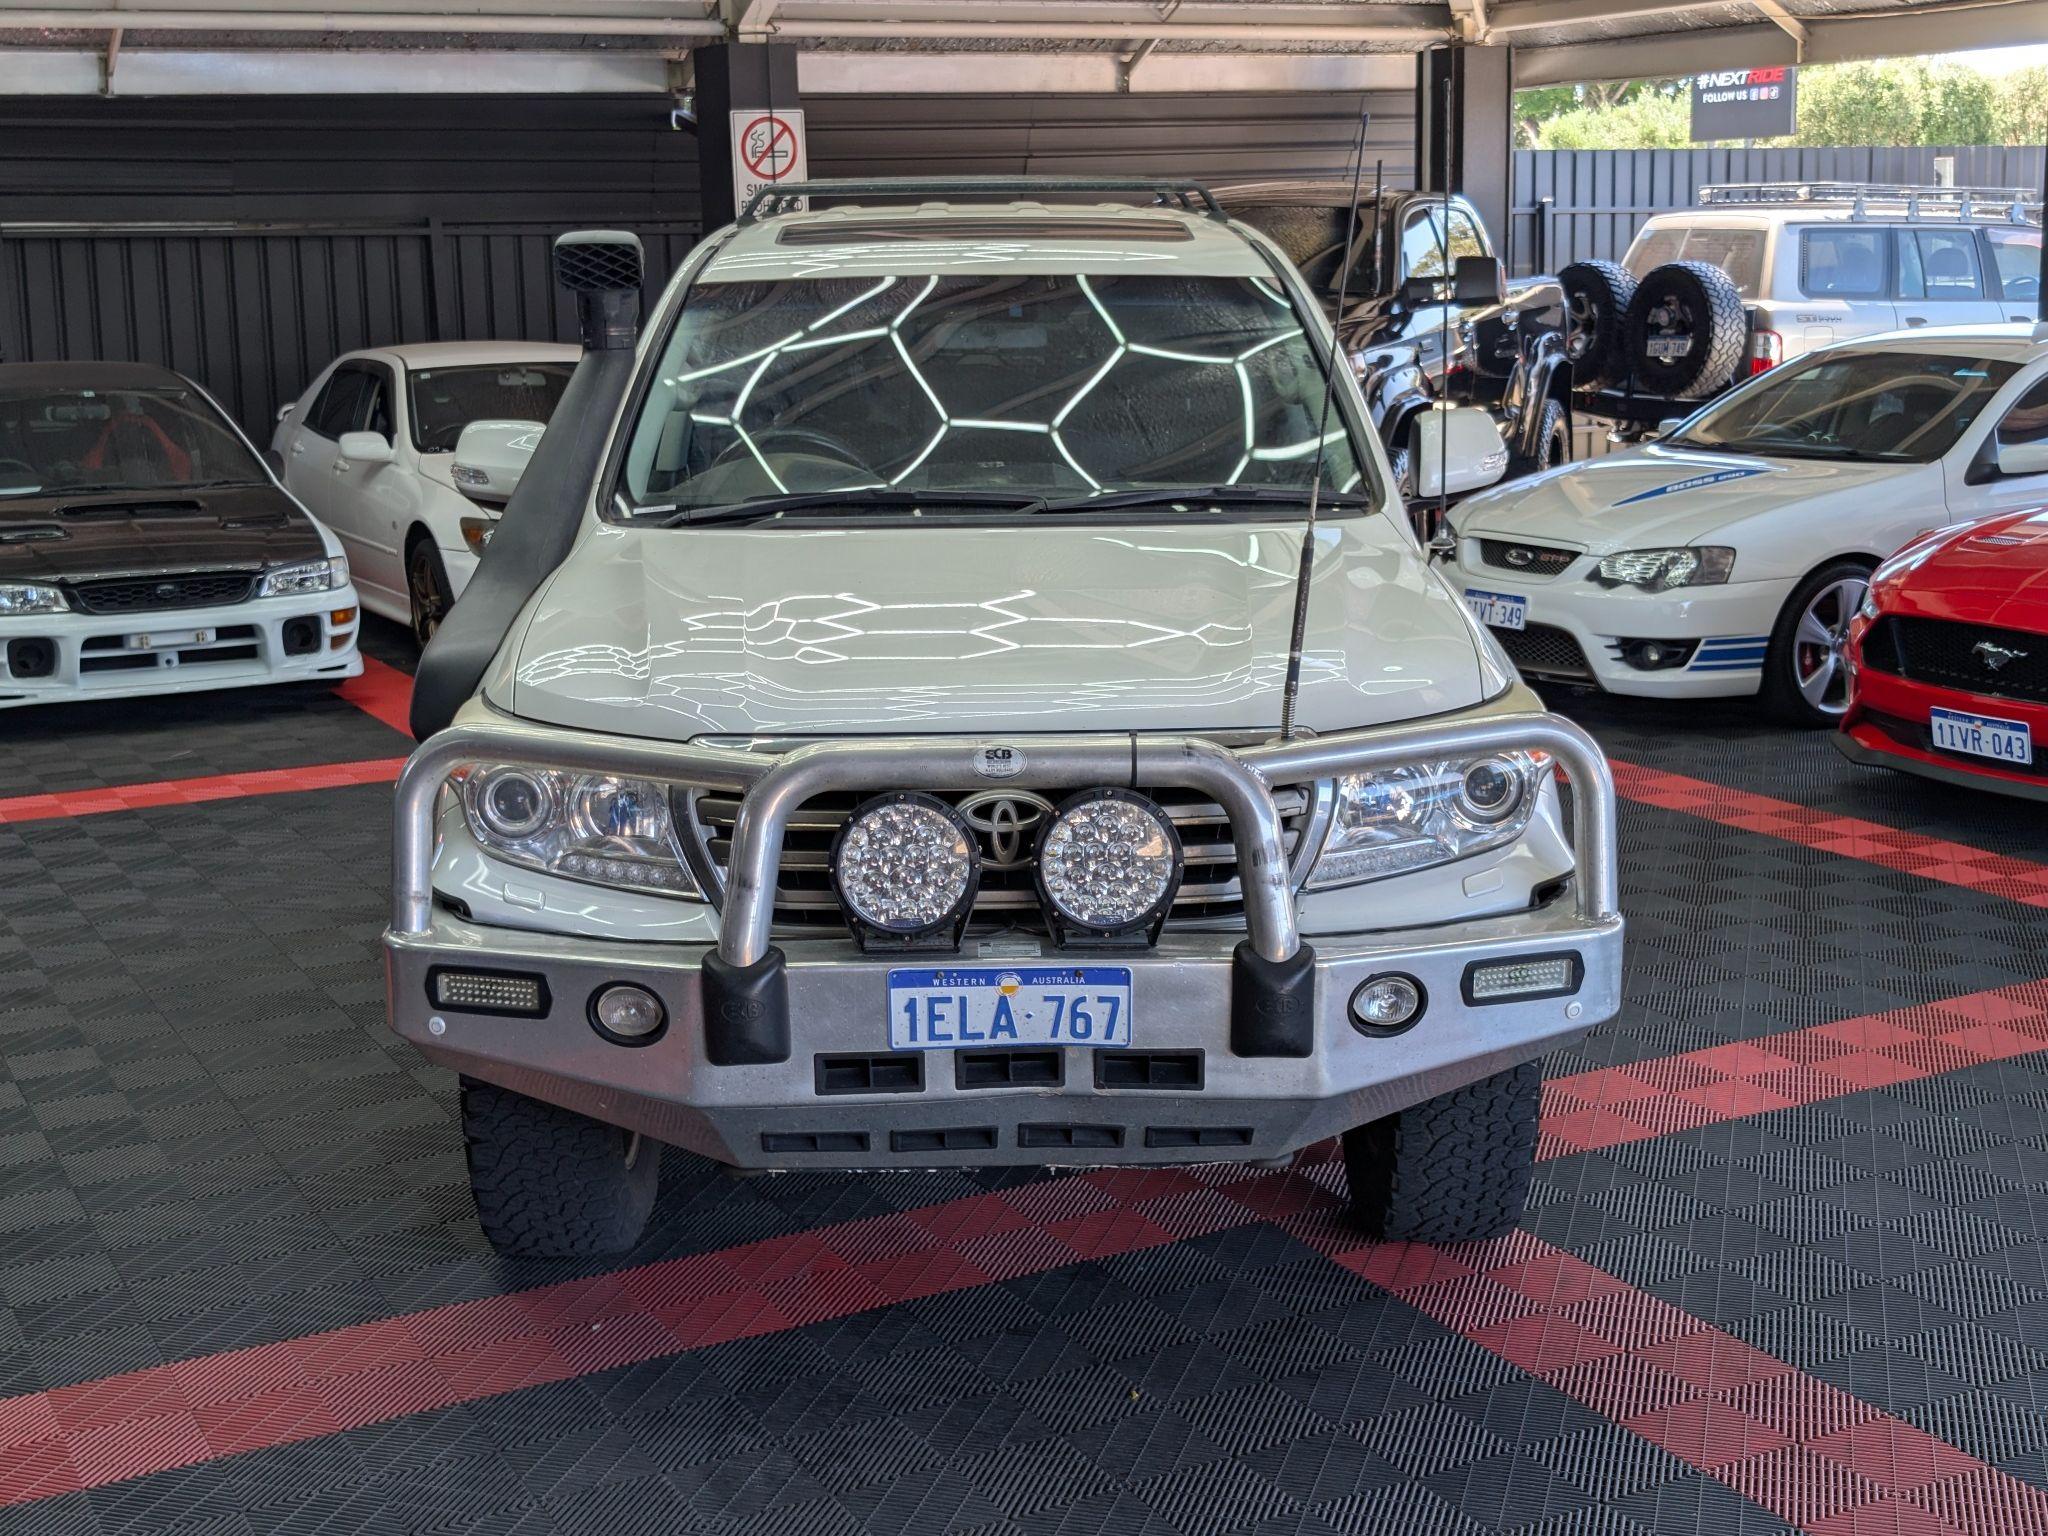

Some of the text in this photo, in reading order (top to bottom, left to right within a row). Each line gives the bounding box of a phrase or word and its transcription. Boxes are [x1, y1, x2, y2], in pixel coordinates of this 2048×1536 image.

[1696, 67, 1785, 89] #NEXTRIDE
[1702, 90, 1748, 103] FOLLOW US
[1665, 476, 1715, 493] BOSS
[932, 976, 1087, 987] WESTERN AUSTRALIA
